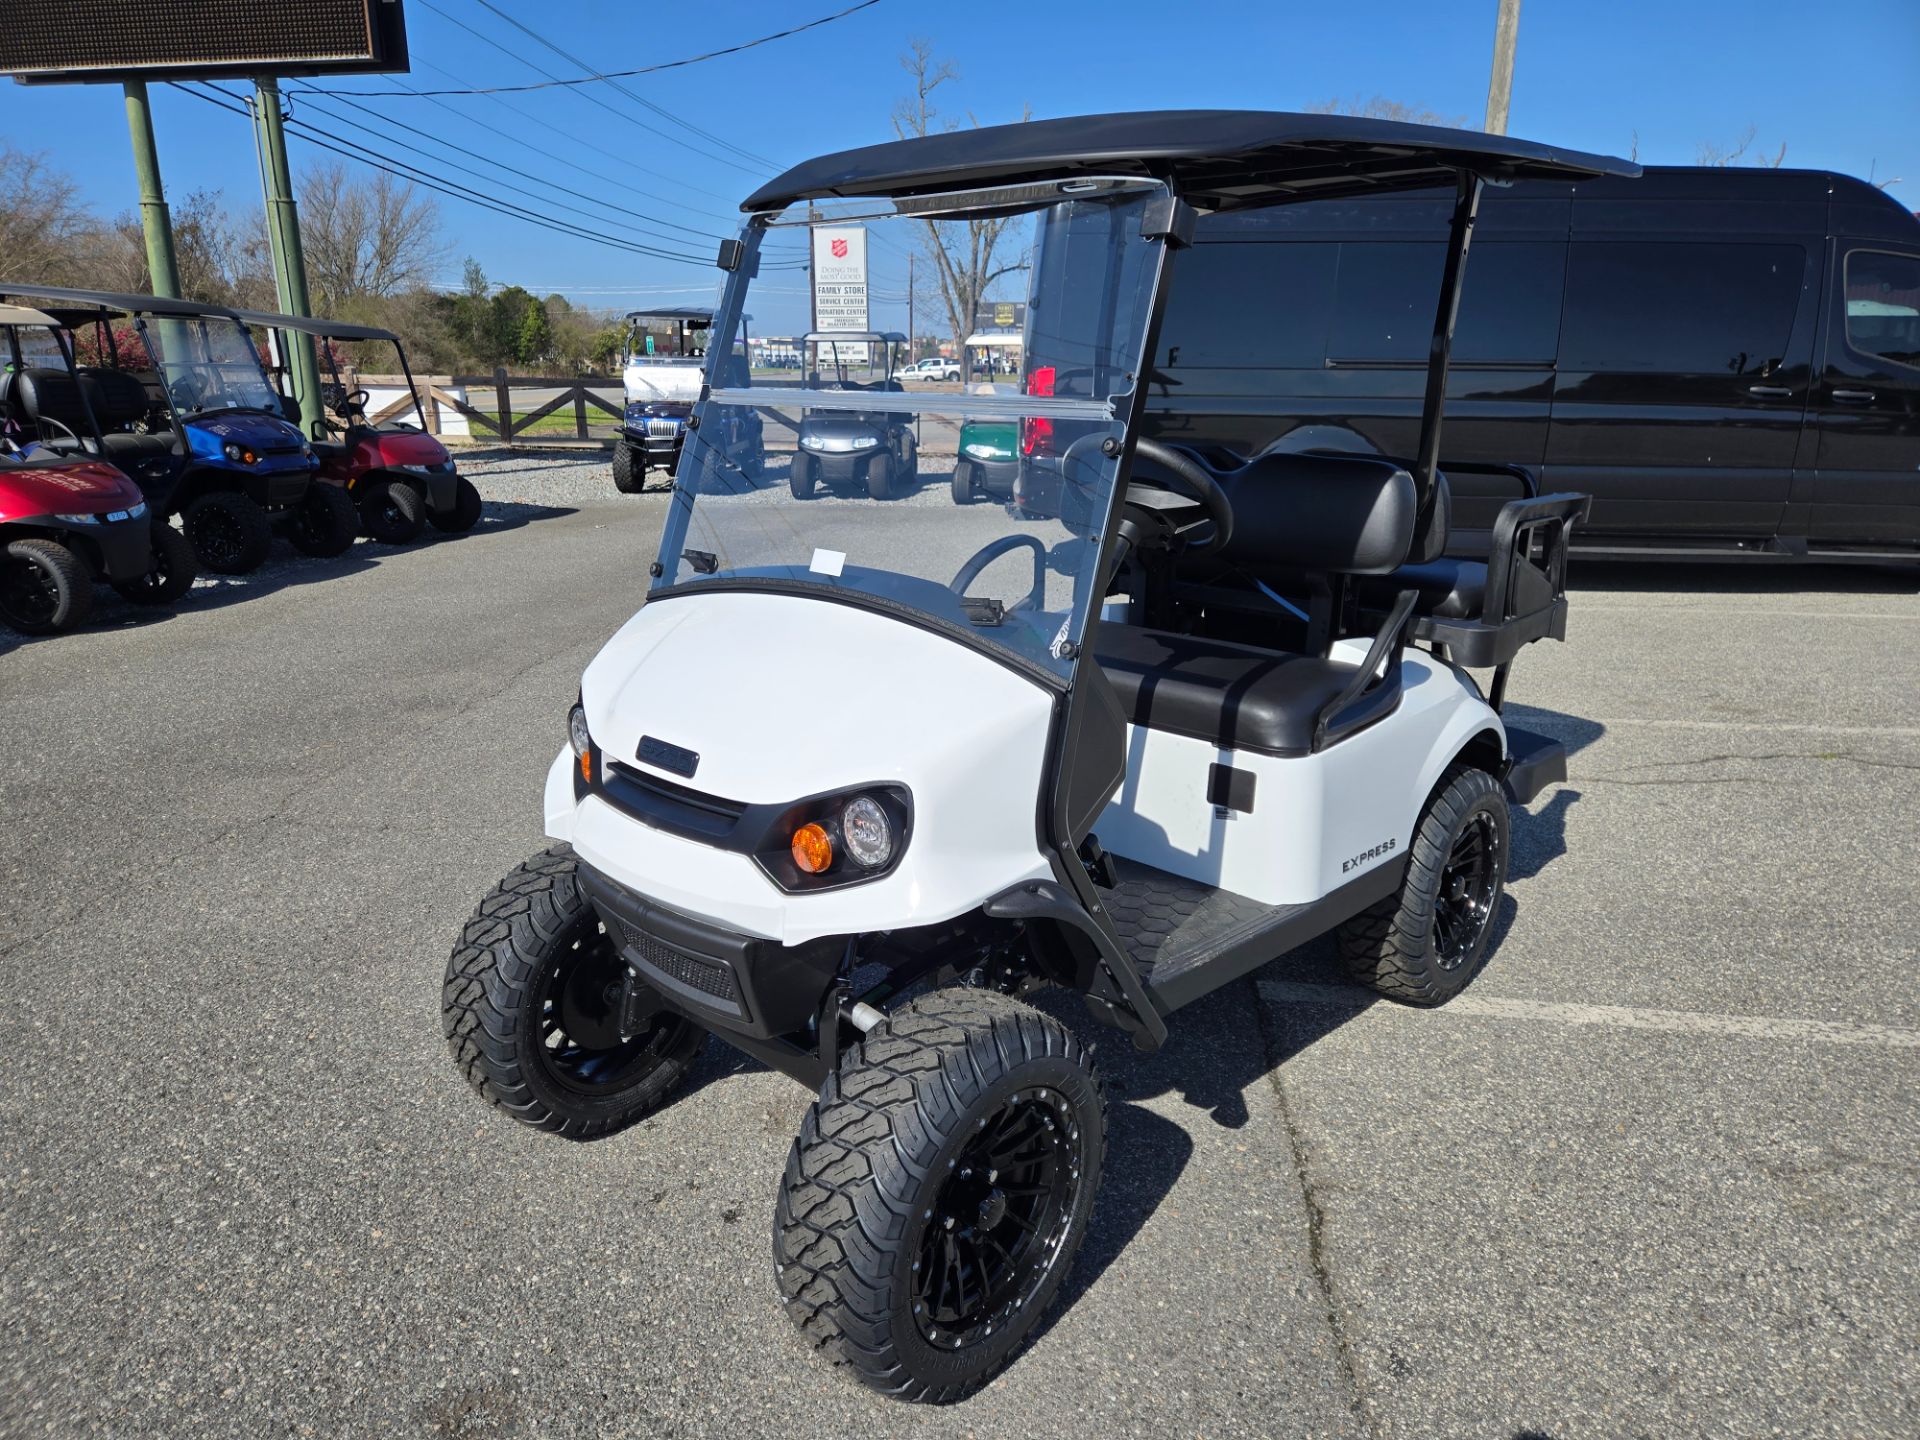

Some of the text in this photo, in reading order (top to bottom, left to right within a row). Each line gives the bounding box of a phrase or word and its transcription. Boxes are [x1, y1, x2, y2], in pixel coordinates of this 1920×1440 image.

[818, 286, 865, 295] FAMILY STORE
[818, 308, 867, 316] DONATION CENTER
[1342, 838, 1396, 874] EXPRESS
